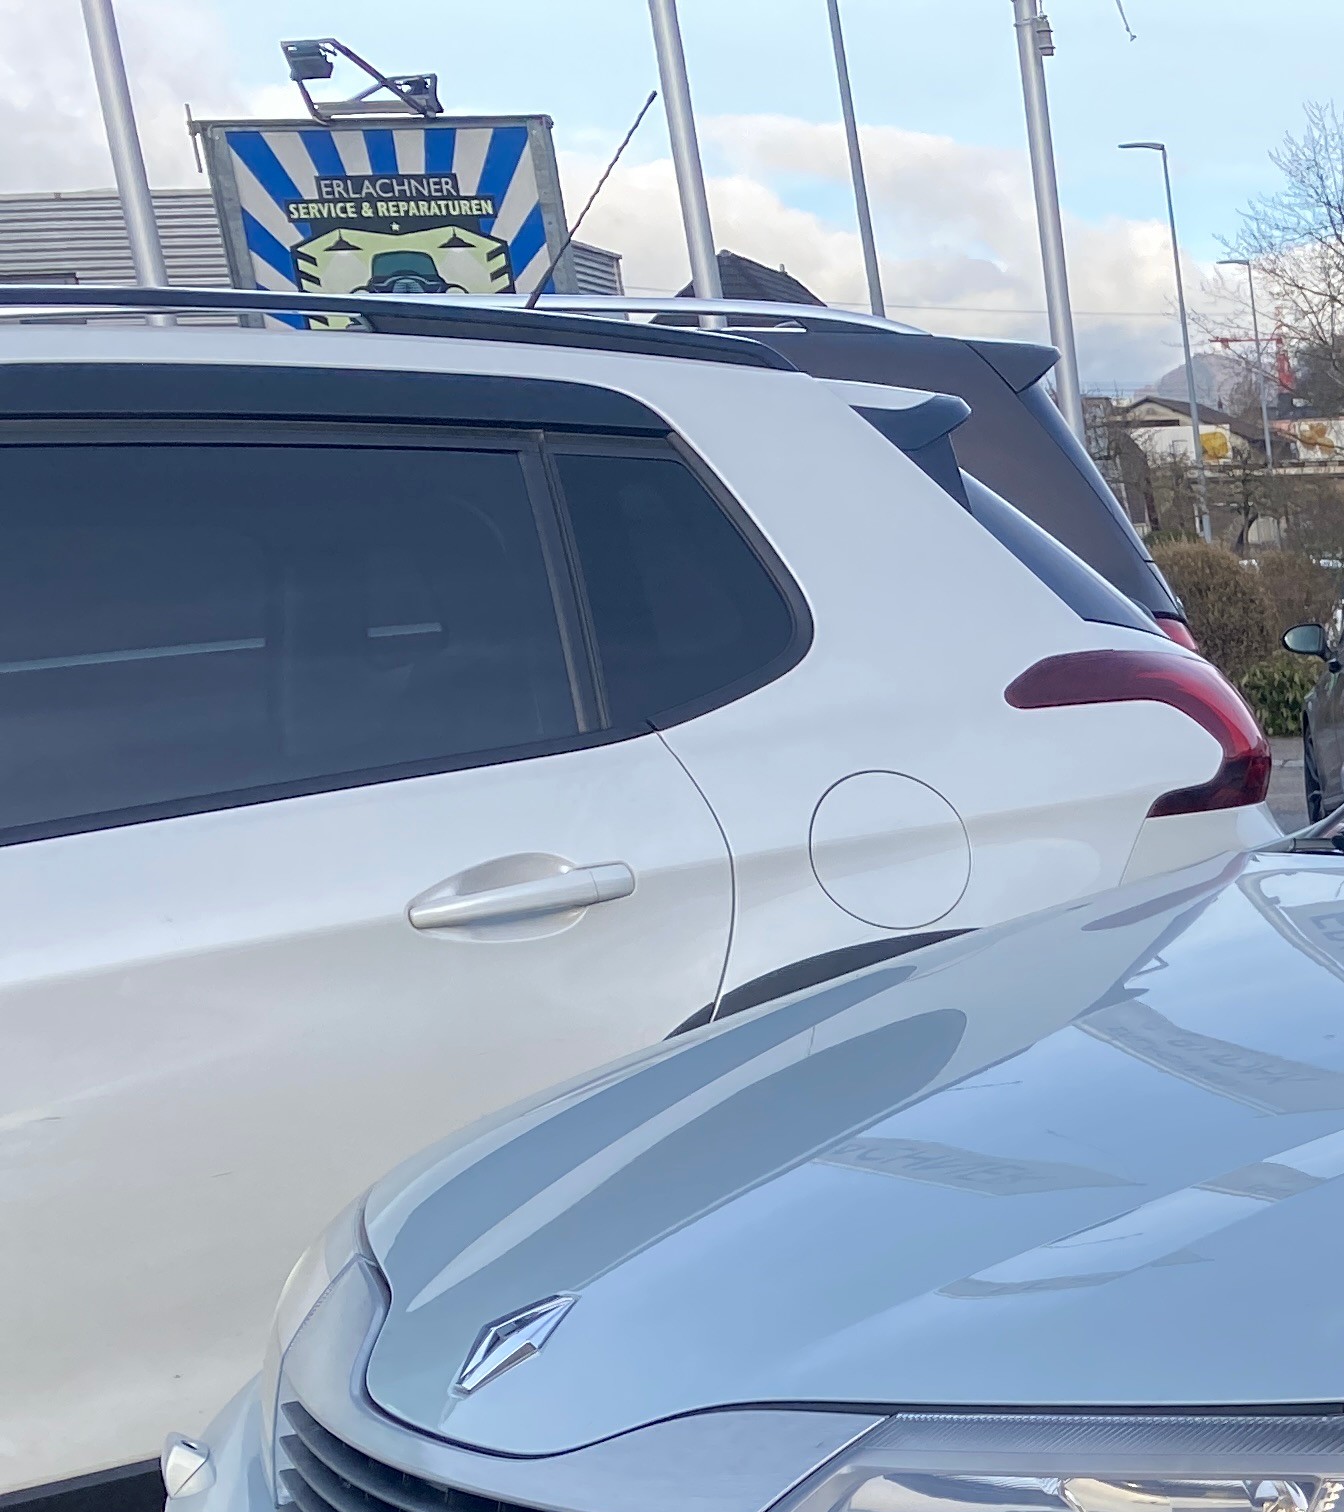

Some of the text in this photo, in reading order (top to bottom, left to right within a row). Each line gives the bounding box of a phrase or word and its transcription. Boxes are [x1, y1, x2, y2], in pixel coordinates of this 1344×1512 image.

[319, 177, 458, 199] ERLACHNER
[288, 199, 494, 219] SERVICE & REPARATUREN
